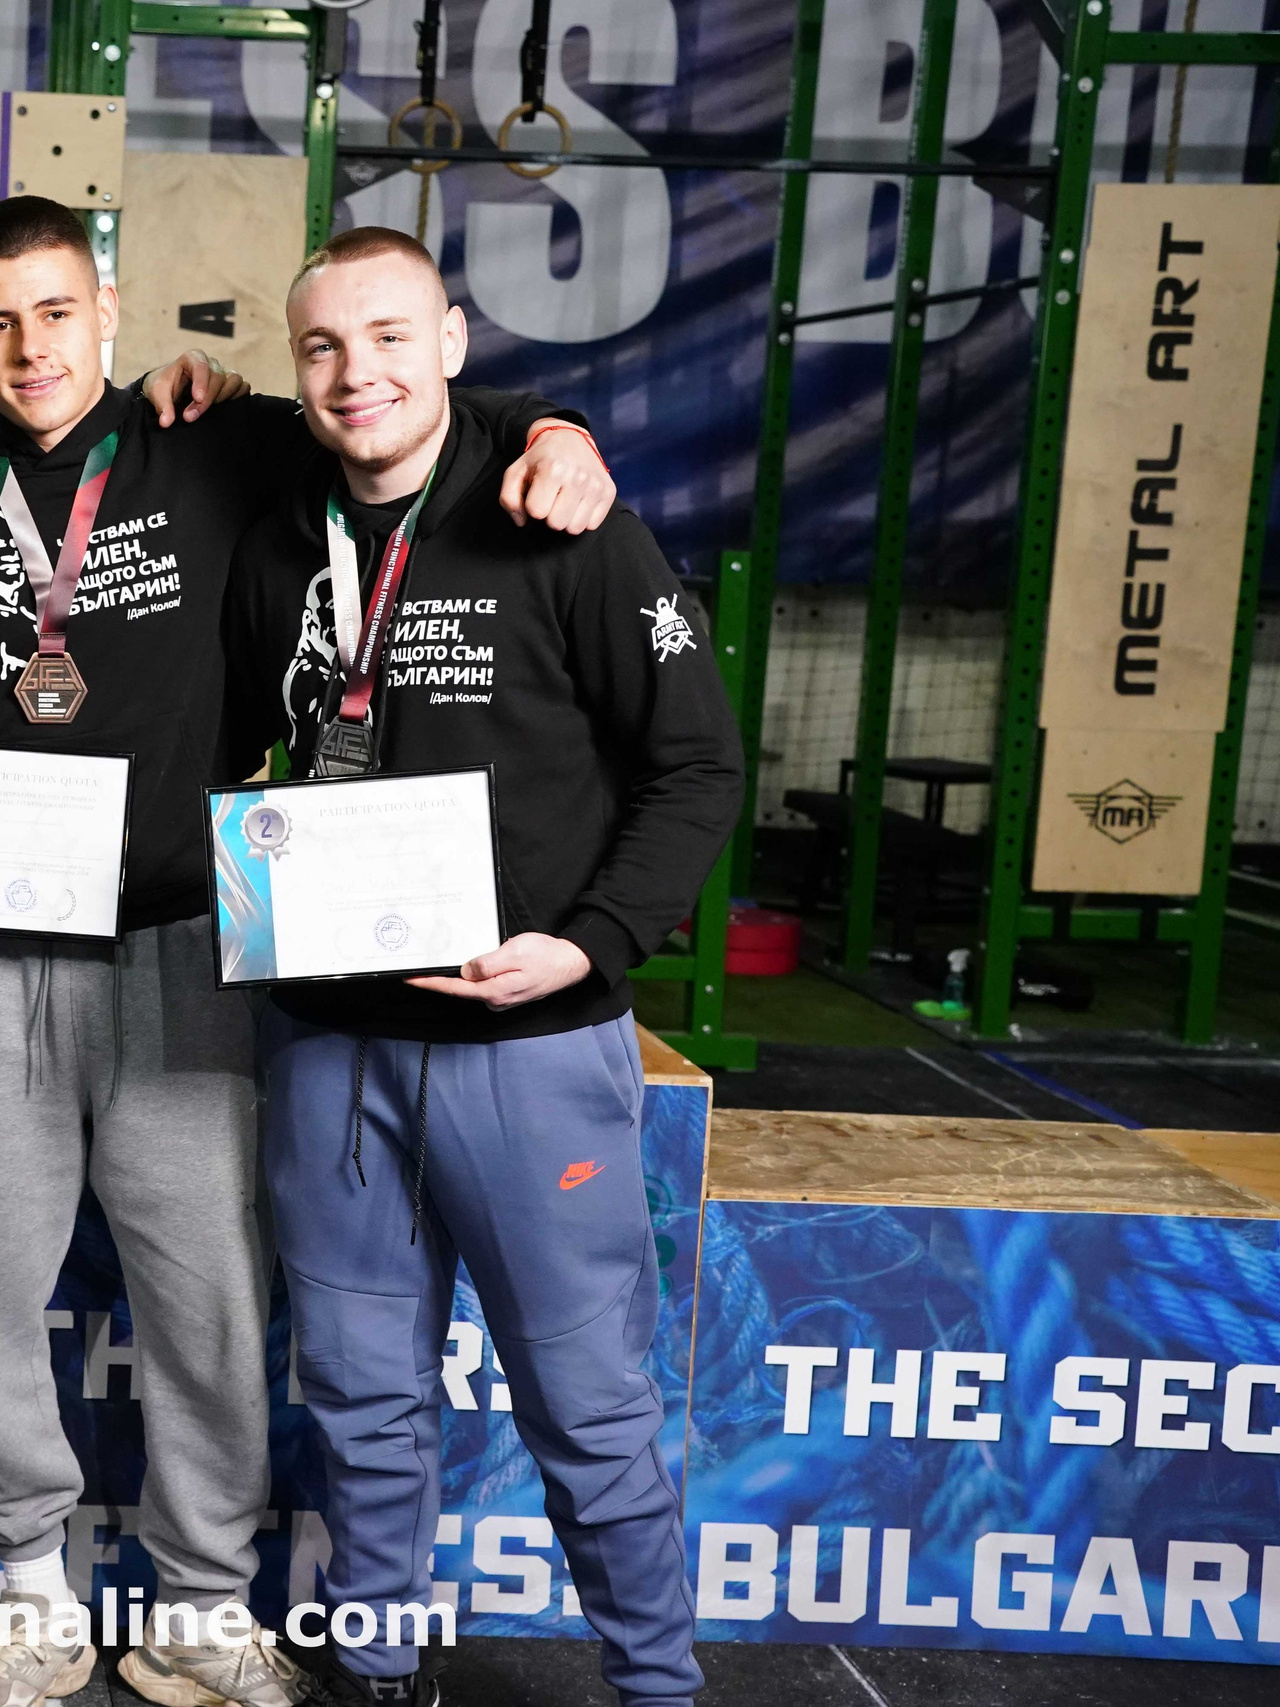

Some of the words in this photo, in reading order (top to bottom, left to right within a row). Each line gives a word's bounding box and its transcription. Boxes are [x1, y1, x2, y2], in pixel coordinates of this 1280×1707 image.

[1146, 222, 1204, 382] ART
[57, 518, 145, 547] СТВАМ
[147, 511, 168, 529] СЕ
[81, 539, 147, 571] ИЛЕН,
[381, 548, 399, 590] FUNCTIONAL
[1114, 422, 1183, 696] METAL
[75, 565, 136, 592] АЩОТО
[139, 554, 177, 576] СЪМ
[373, 591, 388, 619] FITNESS
[474, 599, 497, 614] СЕ
[360, 620, 380, 674] CHAMPIONSHIP
[381, 645, 448, 665] АЩОТО
[451, 645, 493, 661] СЪМ
[60, 776, 98, 788] QUOTA
[319, 803, 410, 817] PARTICIPATION
[414, 798, 456, 812] QUOTA
[566, 1160, 595, 1178] NIKE
[765, 1345, 1006, 1442] THE
[1050, 1356, 1280, 1453] SEC
